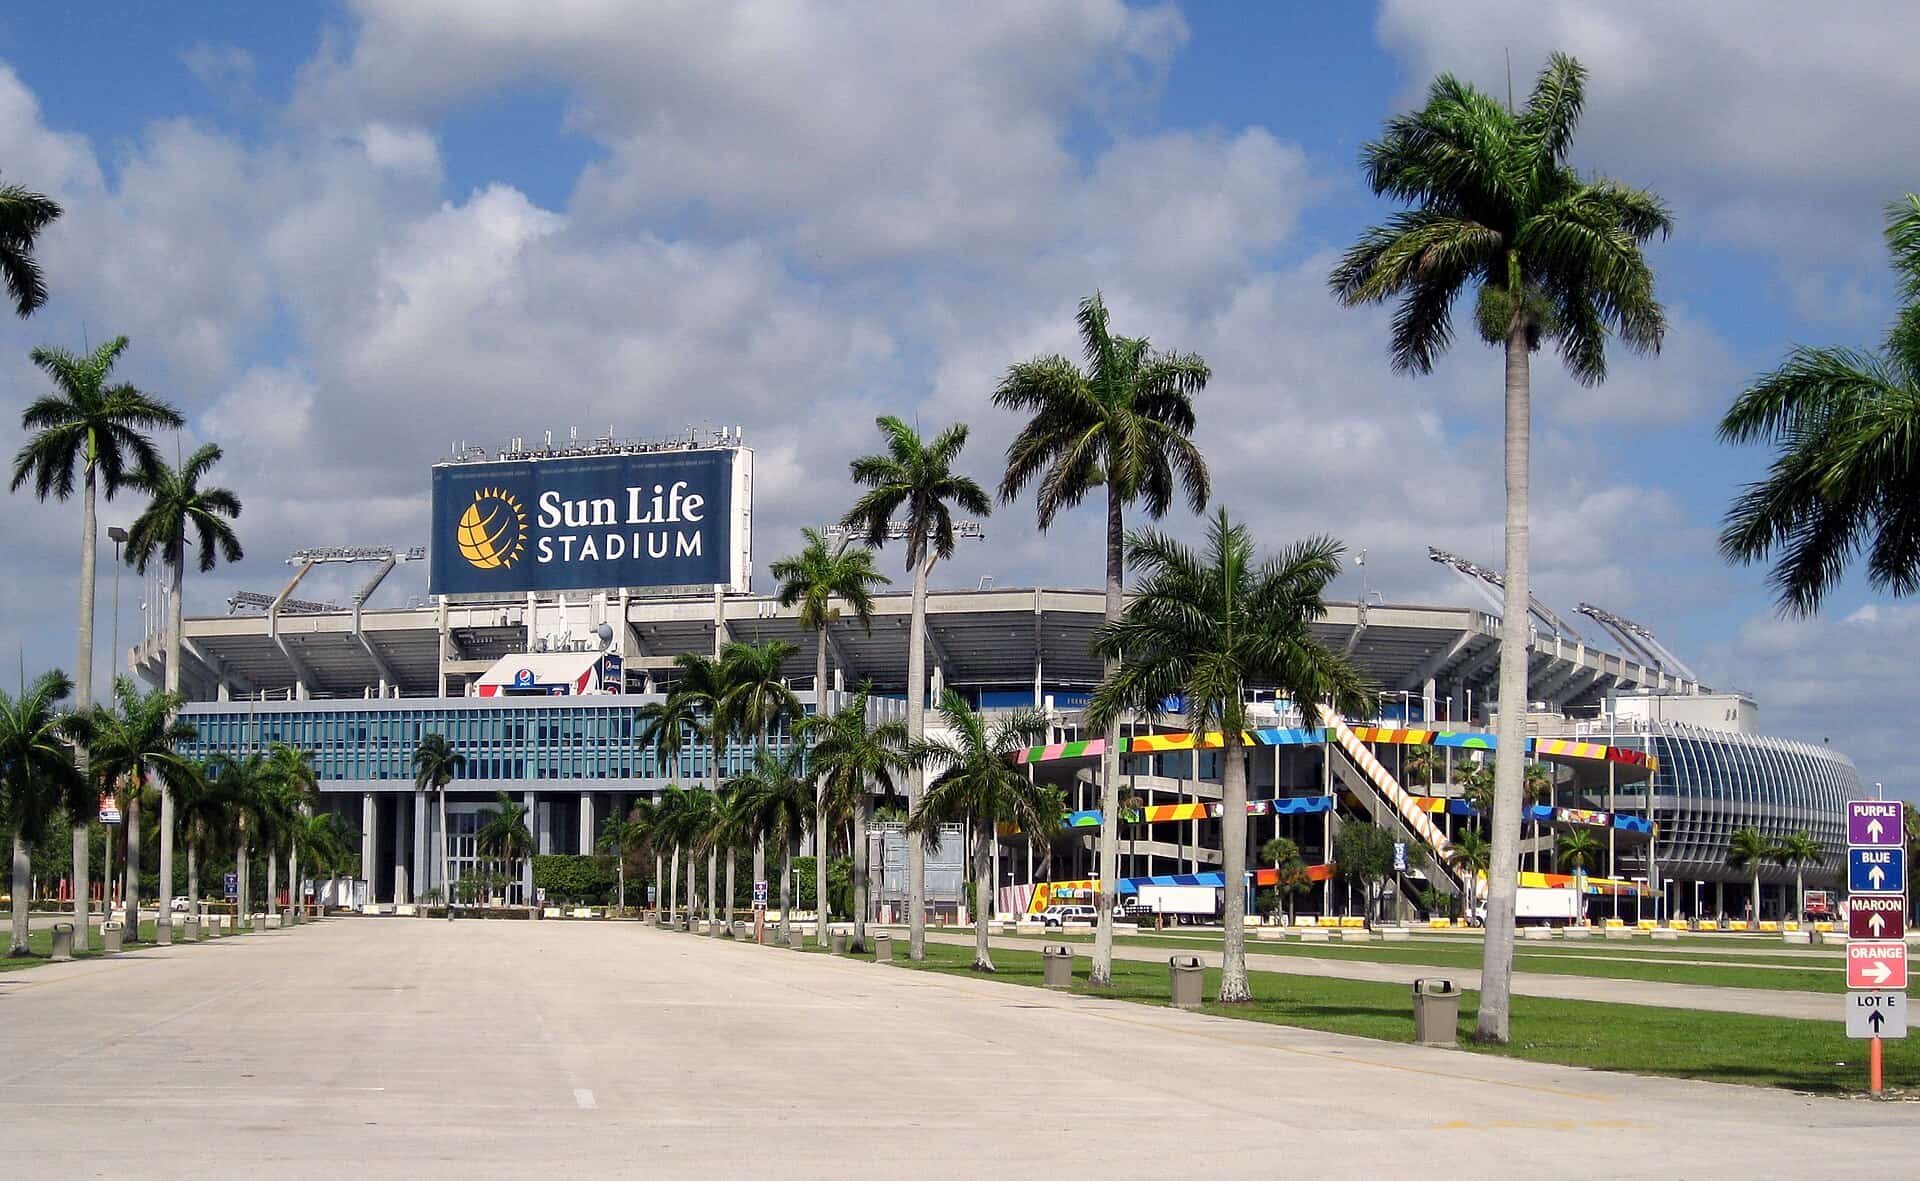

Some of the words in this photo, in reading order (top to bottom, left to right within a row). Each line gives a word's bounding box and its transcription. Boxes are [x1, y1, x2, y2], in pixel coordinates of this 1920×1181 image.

[537, 490, 617, 528] Sun
[626, 481, 704, 523] Life
[537, 529, 702, 563] STADIUM
[1854, 805, 1896, 817] PURPLE
[1862, 852, 1891, 864] BLUE
[1851, 900, 1902, 911] MAROON
[1851, 947, 1903, 959] ORANGE
[1857, 996, 1881, 1007] LOT
[1887, 996, 1895, 1007] E
